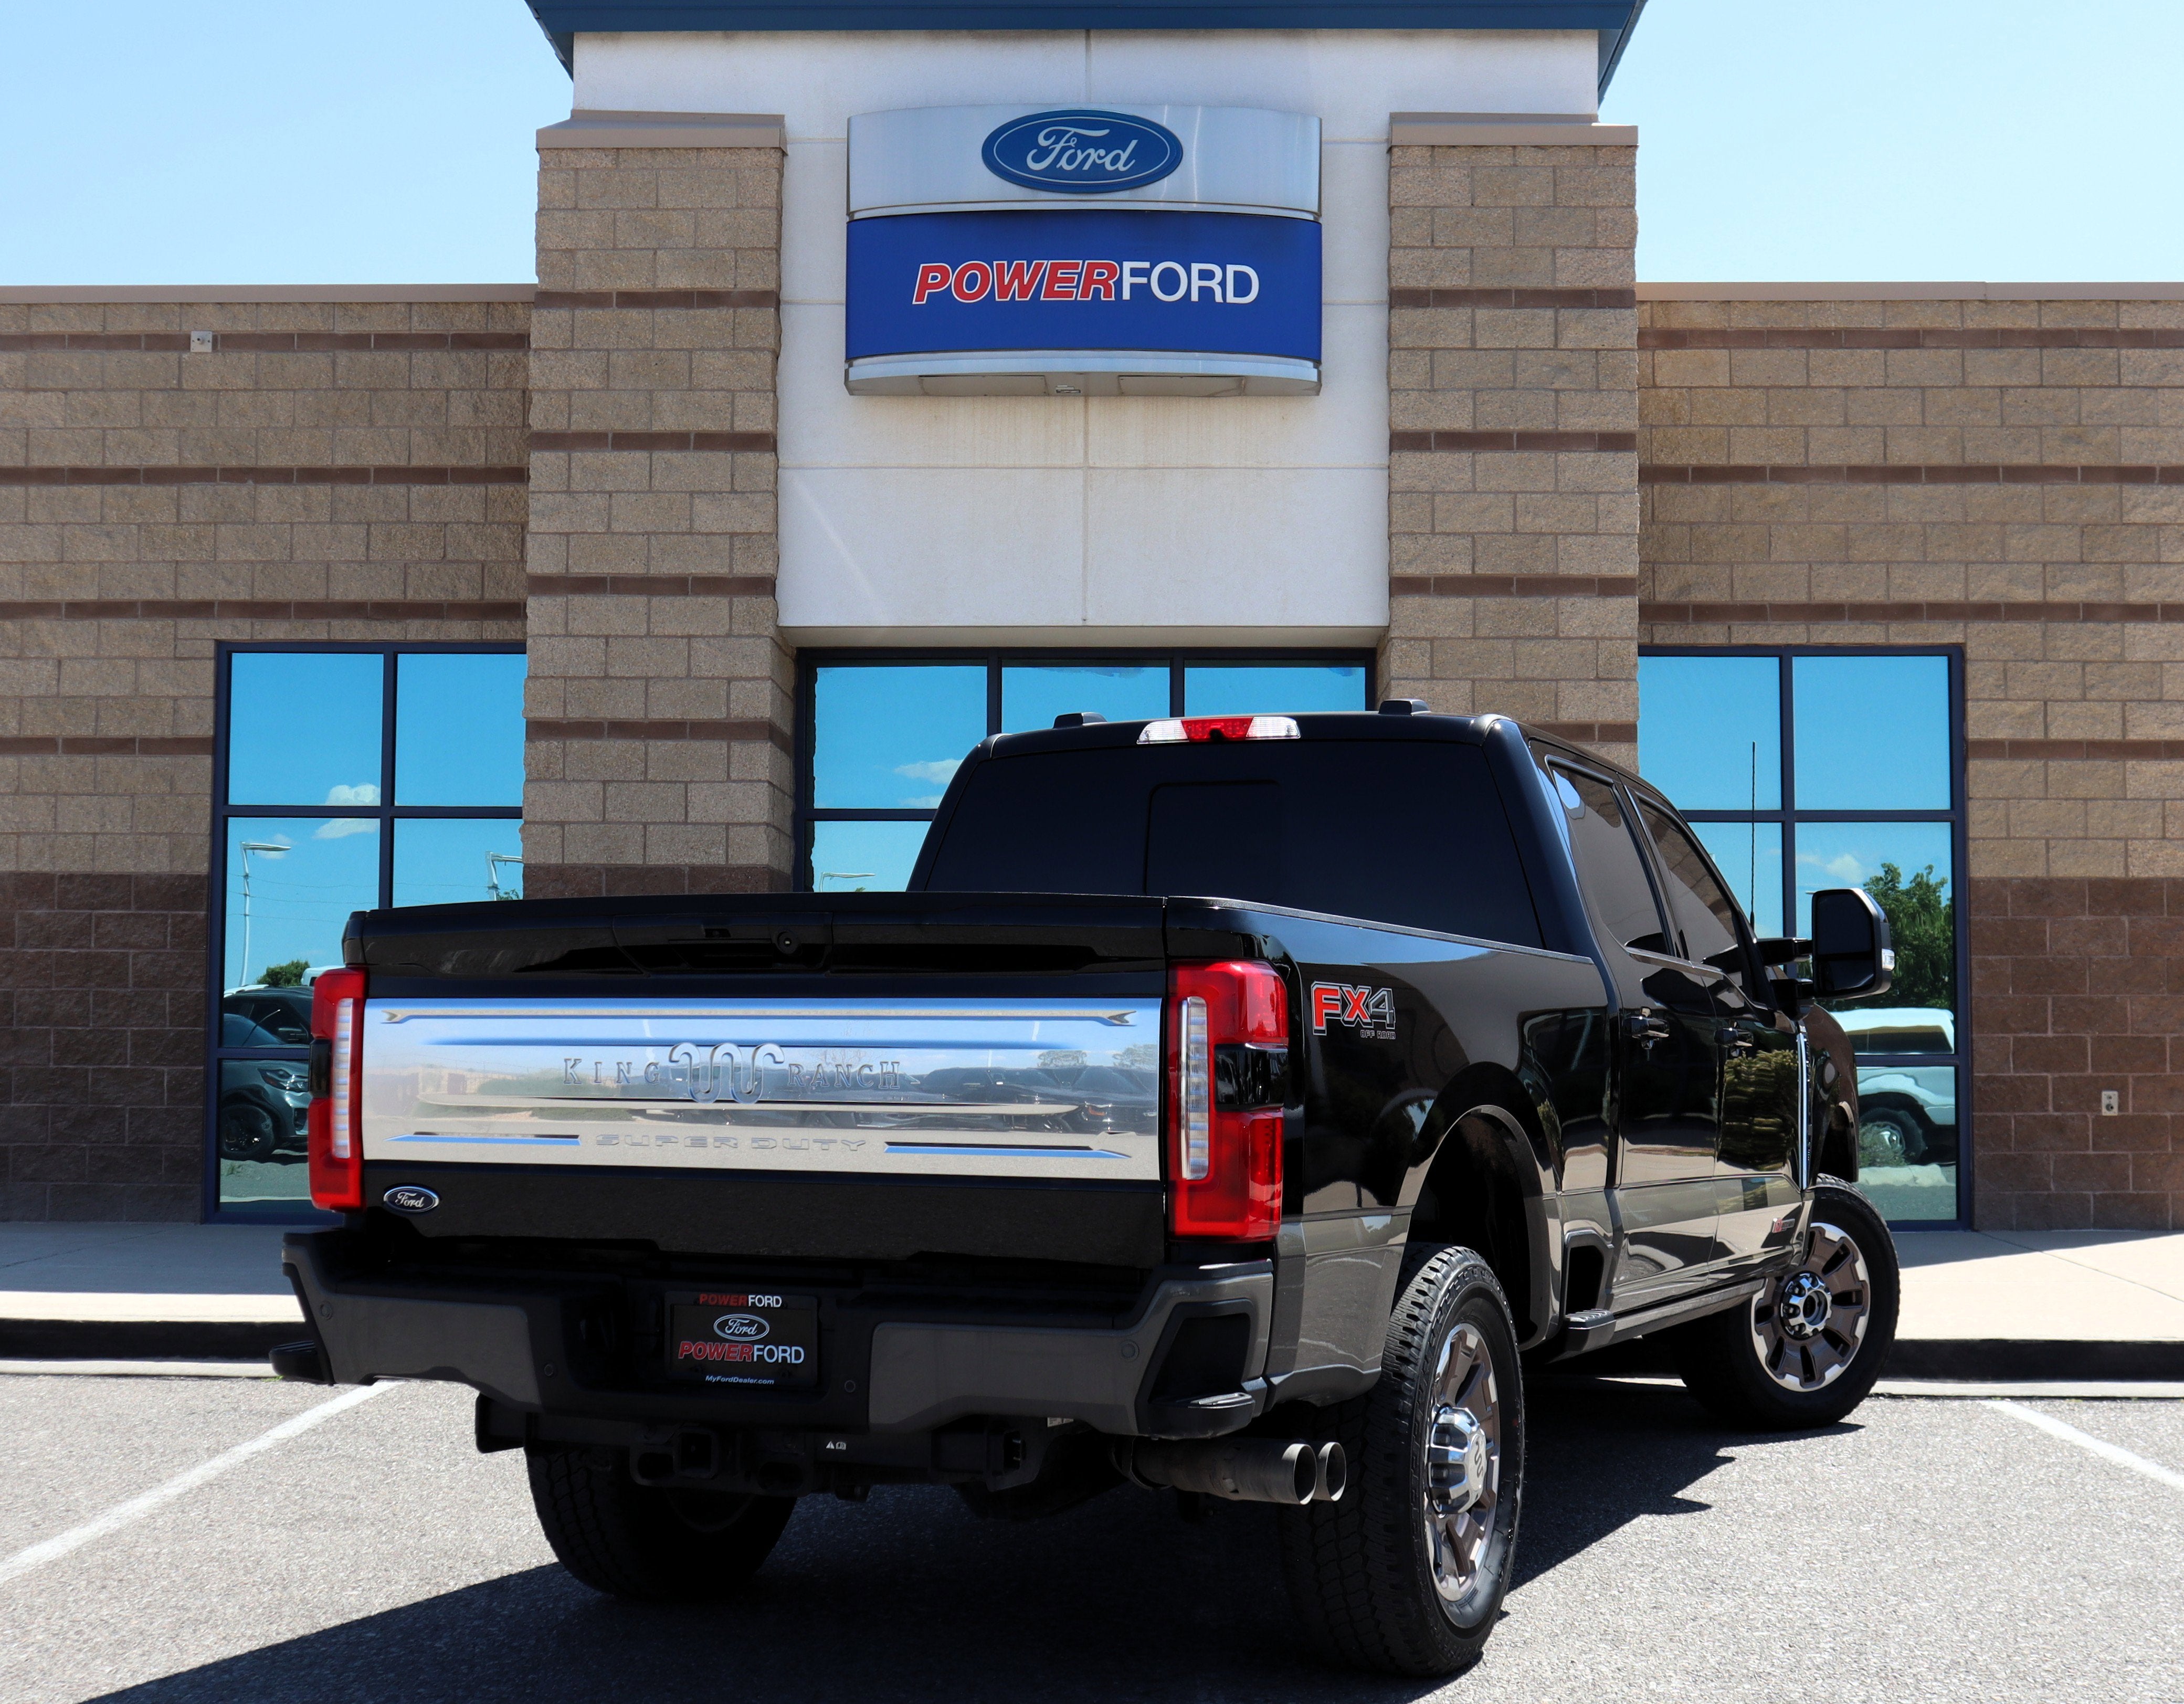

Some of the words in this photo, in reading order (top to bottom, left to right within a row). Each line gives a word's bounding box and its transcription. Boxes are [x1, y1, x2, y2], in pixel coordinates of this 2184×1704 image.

[1026, 125, 1138, 173] Ford
[912, 260, 1259, 304] POWERFORD
[1311, 981, 1396, 1036] FX4
[1360, 1029, 1375, 1038] OFF
[1377, 1031, 1396, 1039] ROAD
[563, 1058, 660, 1085] KING
[788, 1061, 900, 1090] RANCH
[596, 1134, 738, 1149] SUPER
[751, 1138, 867, 1151] DUTY
[395, 1192, 425, 1207] Ford
[699, 1293, 782, 1308] POWERFORD
[724, 1318, 758, 1335] Ford
[678, 1341, 805, 1364] POWERFORD
[705, 1375, 775, 1385] MyFordDealer.com
